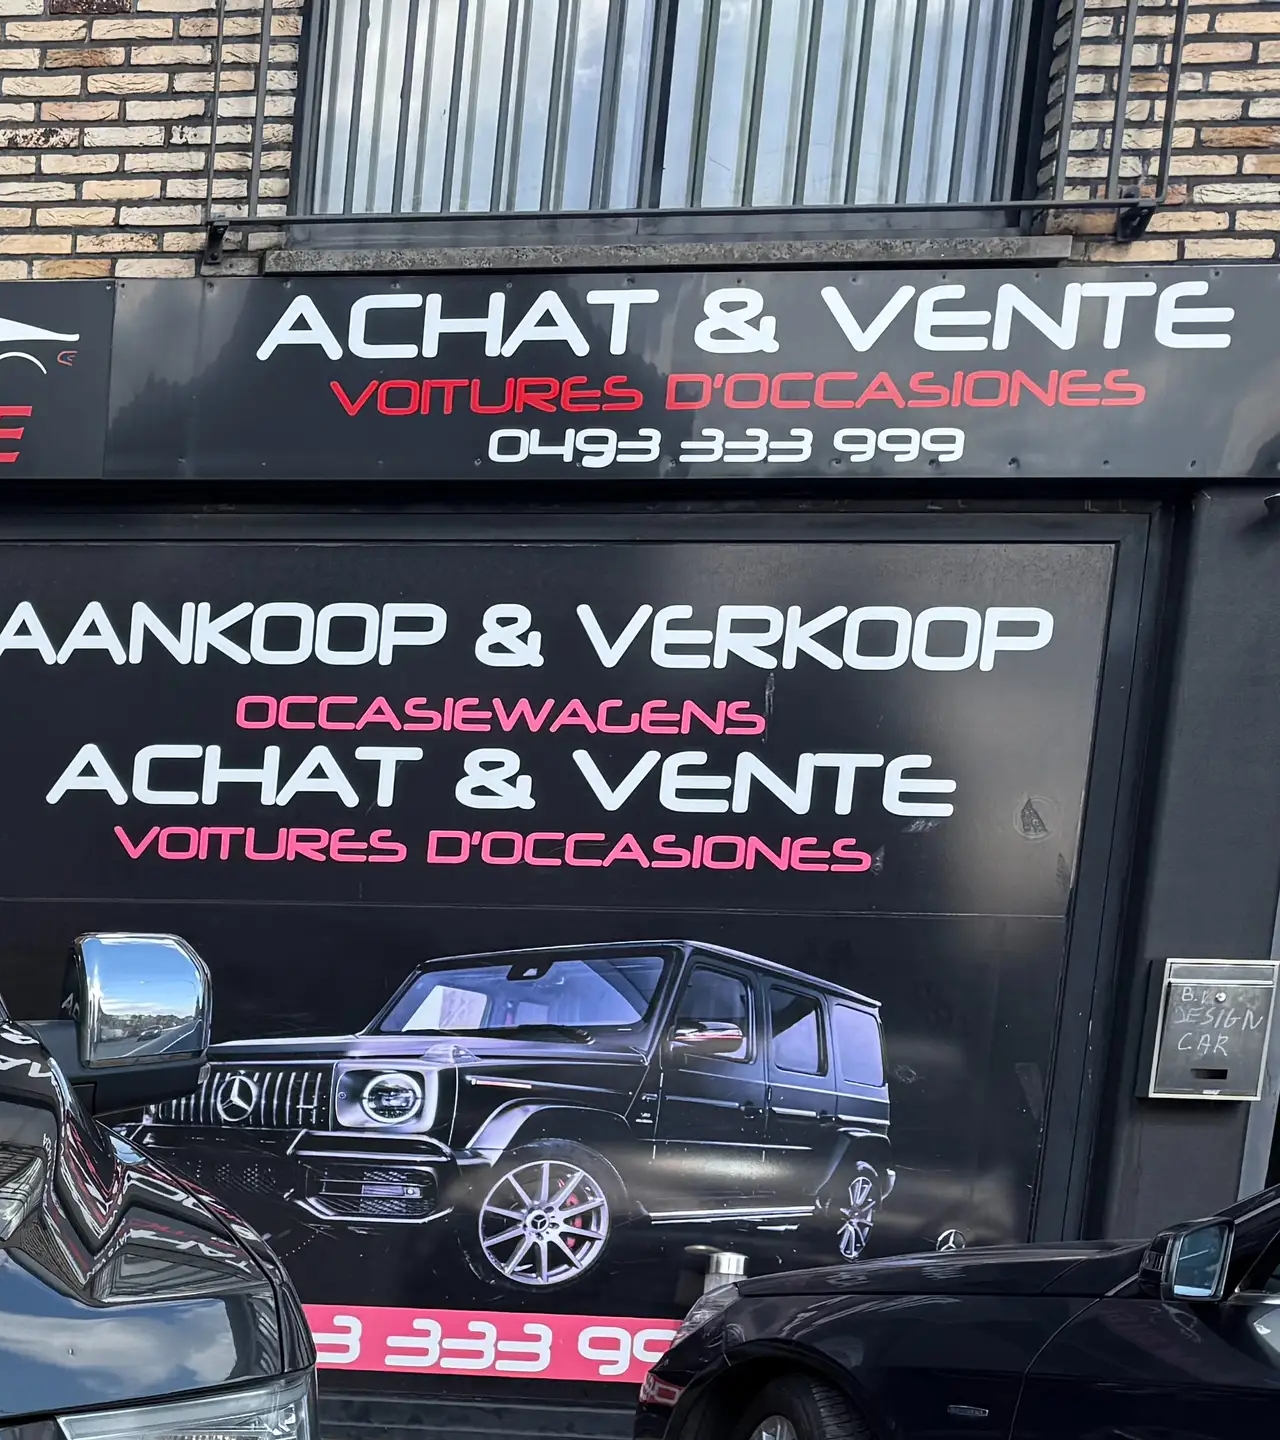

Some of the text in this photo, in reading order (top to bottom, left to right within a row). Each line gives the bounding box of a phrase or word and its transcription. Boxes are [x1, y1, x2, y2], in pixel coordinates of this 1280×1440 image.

[255, 280, 1236, 361] ACHAT & VENTE
[330, 369, 1145, 417] VOITURES D'OCCASIONES
[487, 426, 966, 469] 0493 333 999
[474, 603, 545, 668] &
[576, 603, 1055, 672] VERKOOP
[236, 695, 766, 735] OCCASIEWAGENS
[45, 743, 424, 808] ACHAT
[454, 747, 536, 810] &
[572, 749, 957, 817] VENTE
[115, 826, 872, 873] VOITURES D'OCCASIONES
[1174, 1005, 1264, 1031] DESIGN
[1177, 1032, 1230, 1056] CAR
[384, 1317, 553, 1373] 333
